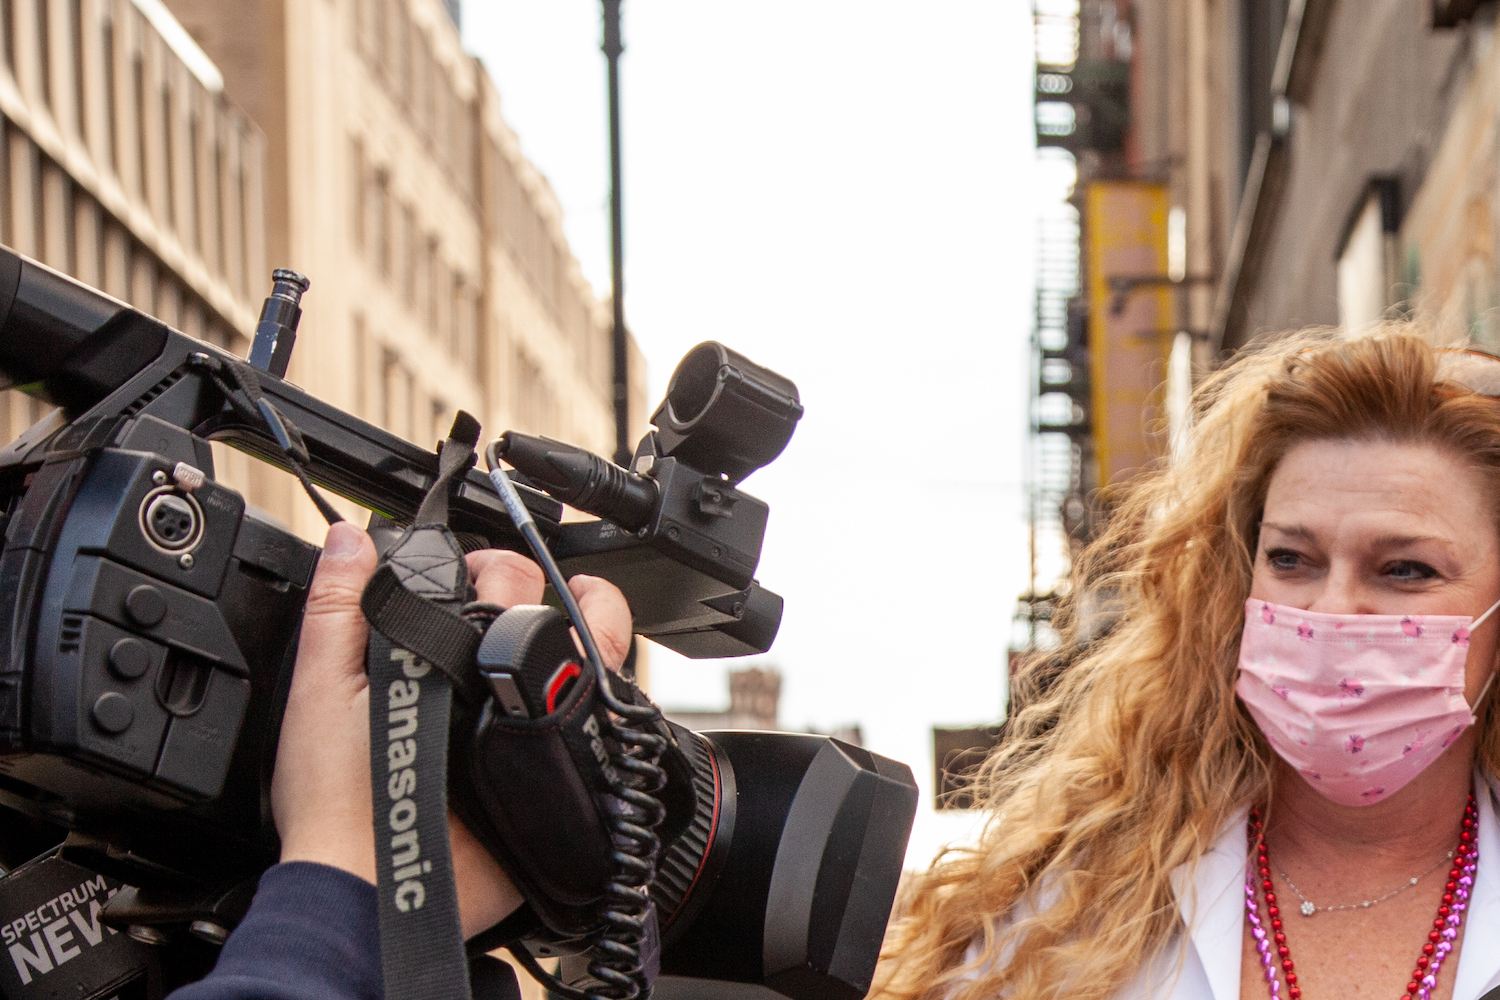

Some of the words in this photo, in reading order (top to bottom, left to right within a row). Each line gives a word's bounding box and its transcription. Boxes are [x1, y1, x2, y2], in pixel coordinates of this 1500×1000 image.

[387, 648, 432, 912] Panasonic
[1, 874, 107, 945] SPECTRUM
[8, 888, 118, 986] NEW
